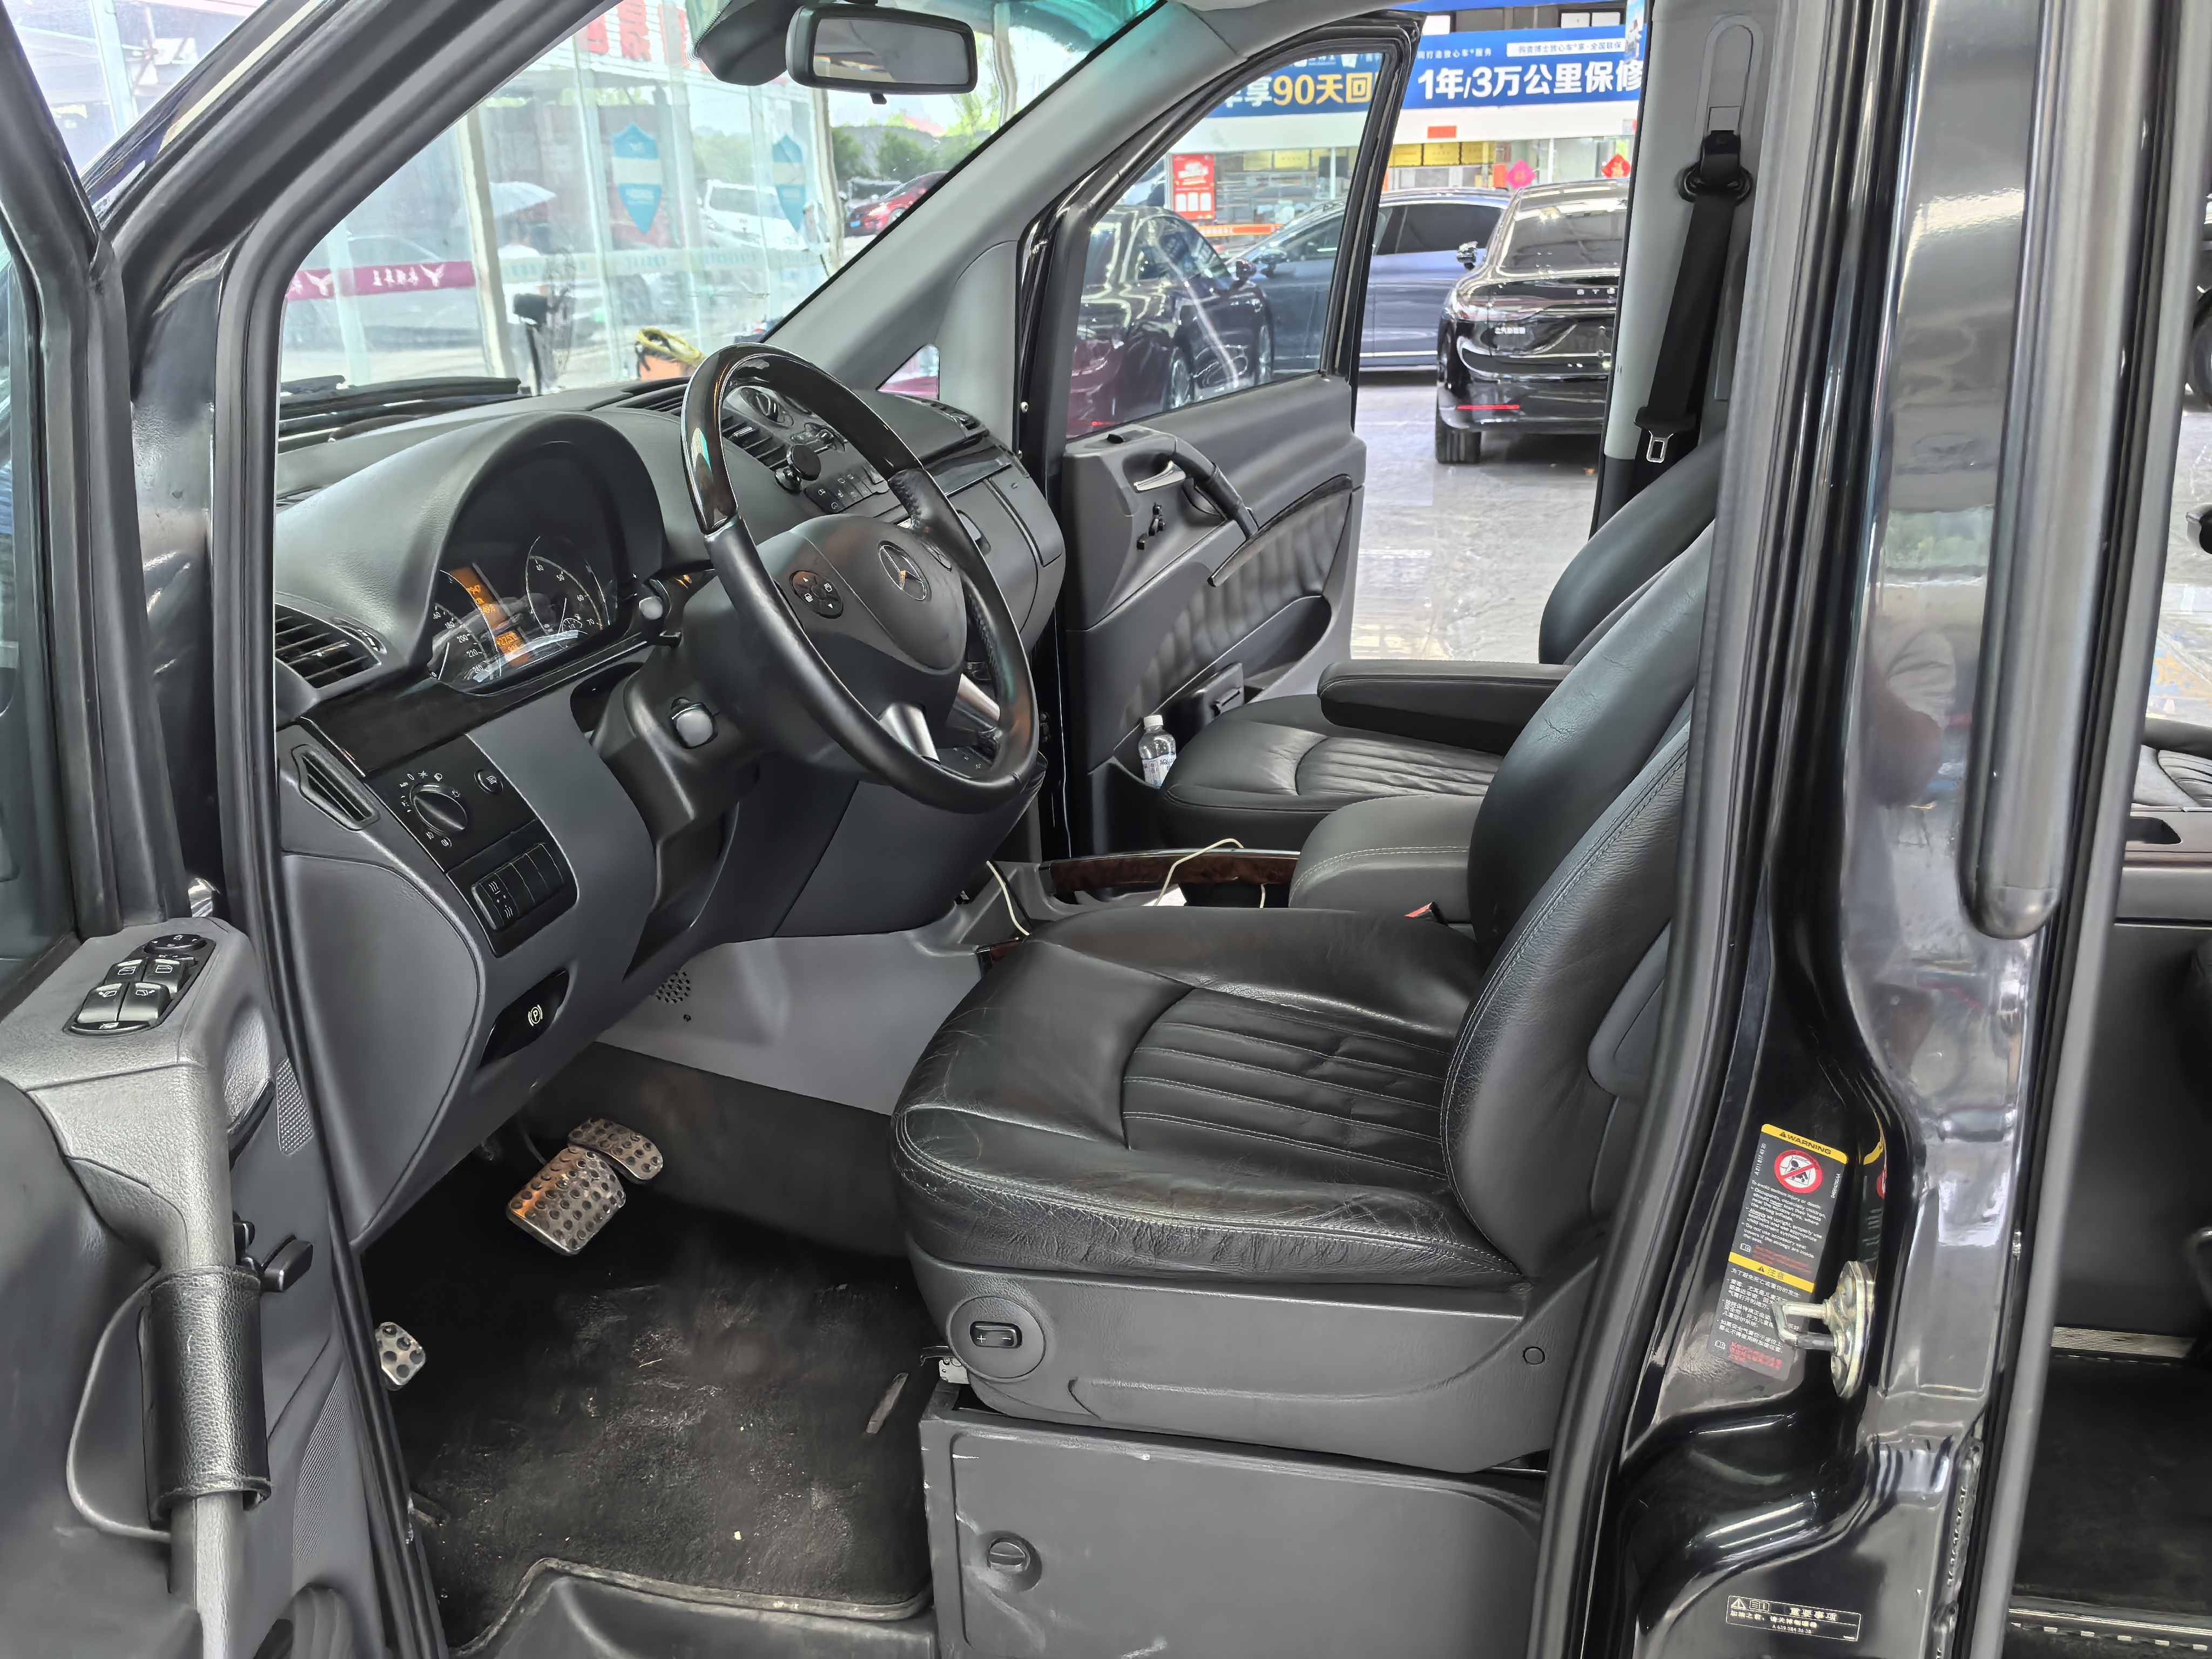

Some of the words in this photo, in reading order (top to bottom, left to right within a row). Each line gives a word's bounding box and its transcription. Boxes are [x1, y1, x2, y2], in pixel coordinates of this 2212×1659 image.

[1418, 59, 1643, 100] 1年/3万公里保修
[1224, 71, 1379, 108] 享90天回
[444, 621, 455, 630] 180
[456, 634, 468, 643] 200
[466, 649, 478, 658] 220
[473, 664, 483, 673] 240
[1787, 1134, 1832, 1155] WARNING
[1754, 1193, 1769, 1202] should
[1807, 1213, 1821, 1221] heads
[1782, 1199, 1805, 1210] especially
[1759, 1206, 1775, 1215] airbag
[1758, 1223, 1779, 1232] restraint
[1793, 1225, 1813, 1235] properly
[1744, 1229, 1761, 1237] covers
[1773, 1241, 1790, 1249] airbags
[1771, 1234, 1795, 1245] accessory
[1790, 1229, 1817, 1242] appropriate
[1766, 1267, 1785, 1281] 注意
[1789, 1608, 1837, 1622] 重要事项
